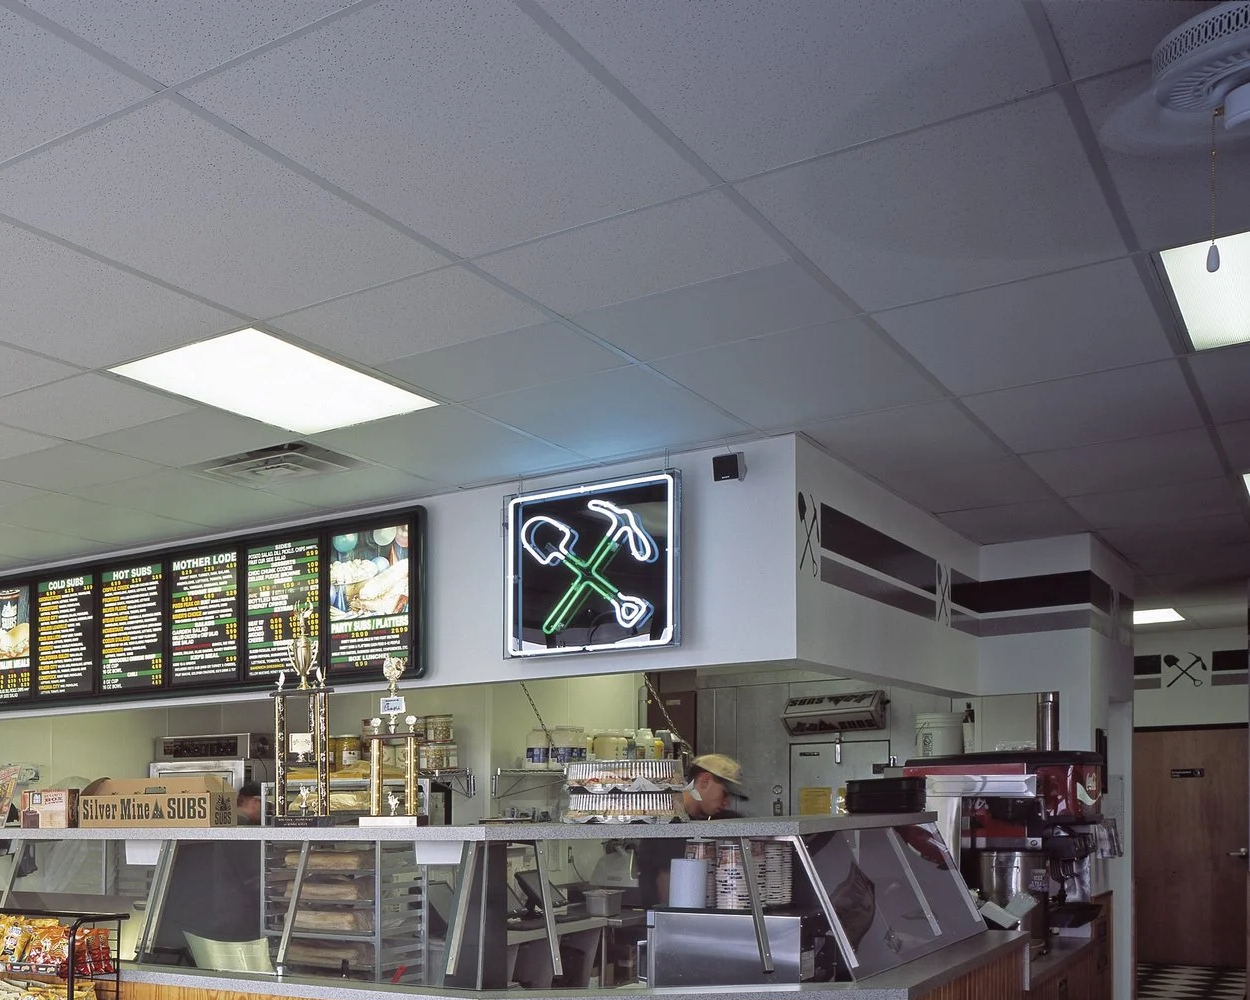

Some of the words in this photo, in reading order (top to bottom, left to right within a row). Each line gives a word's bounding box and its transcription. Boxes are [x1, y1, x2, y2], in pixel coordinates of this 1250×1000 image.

[173, 556, 211, 571] MOTHER
[213, 552, 237, 565] LODE
[112, 569, 130, 581] HOT
[131, 566, 152, 578] SUBS
[48, 580, 66, 591] COLD
[66, 577, 84, 588] SUBS
[331, 621, 352, 634] PARTY
[353, 619, 371, 631] SUBS
[375, 614, 409, 629] PLATTERS
[348, 653, 362, 662] BOX
[82, 798, 117, 821] Silver
[120, 798, 150, 820] Mine
[167, 796, 207, 820] SUBS
[214, 812, 232, 826] SUBS
